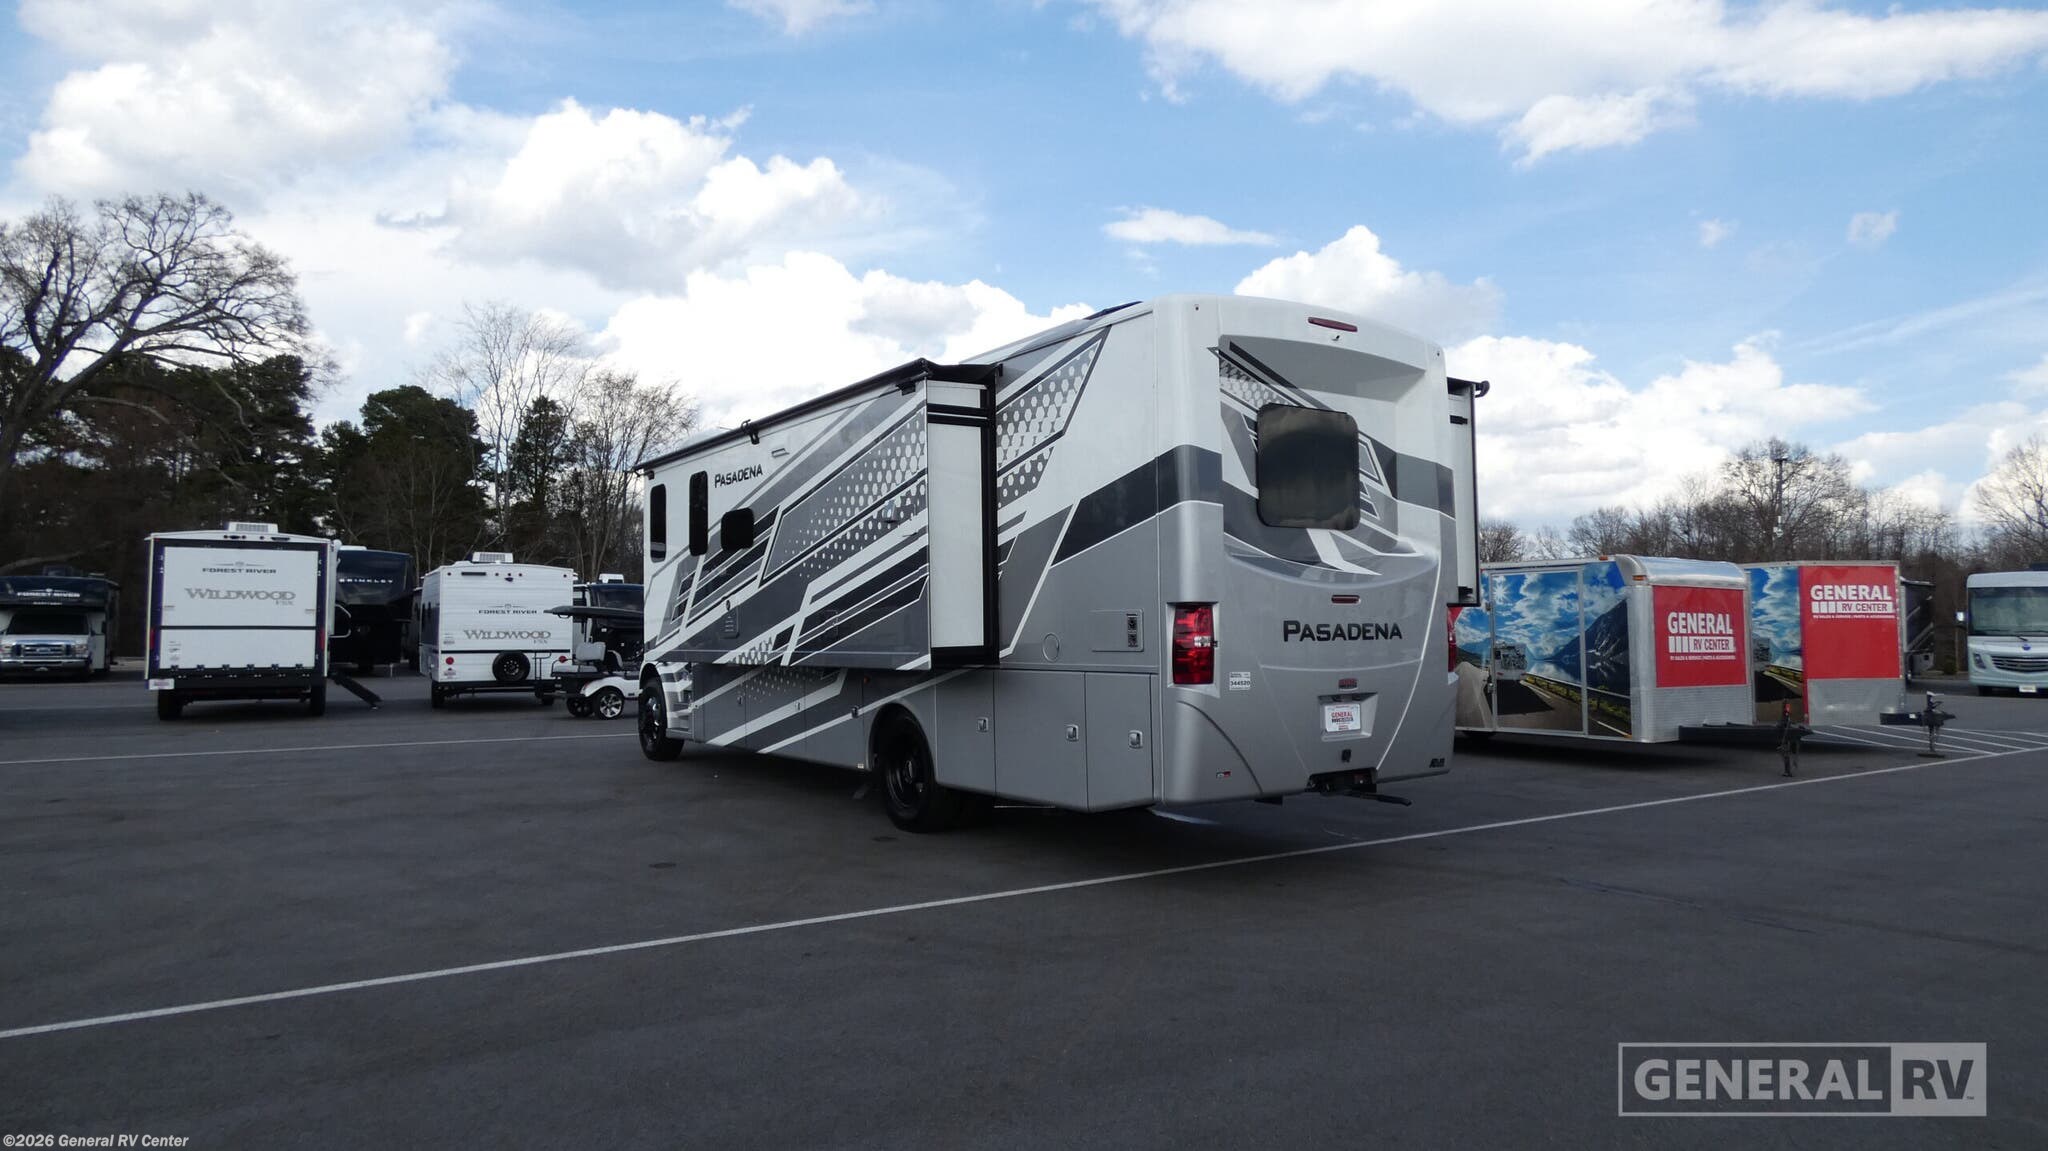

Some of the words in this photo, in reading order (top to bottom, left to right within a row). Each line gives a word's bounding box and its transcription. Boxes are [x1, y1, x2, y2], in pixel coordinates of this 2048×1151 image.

[715, 464, 763, 488] PASADENA
[185, 587, 296, 600] WILDWOOD
[1810, 585, 1892, 600] GENERAL
[1842, 603, 1853, 611] RV
[1855, 603, 1888, 611] CENTER
[1668, 612, 1733, 634] GENERAL
[463, 629, 551, 640] WILDWOOD
[1283, 620, 1403, 642] PASADENA
[1693, 639, 1703, 650] RV
[1704, 639, 1730, 650] CENTER
